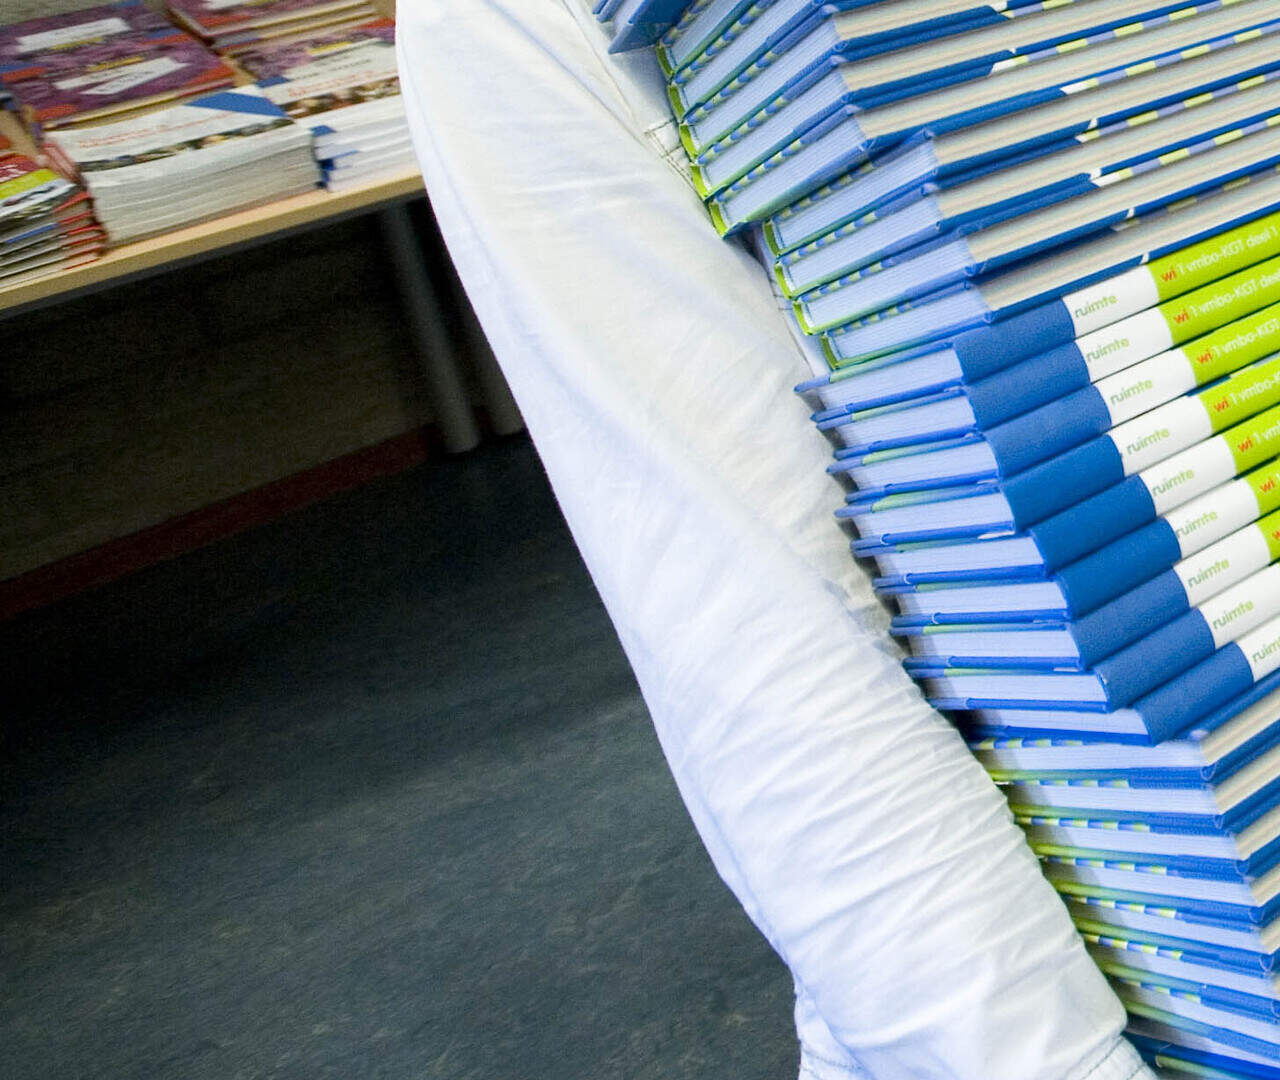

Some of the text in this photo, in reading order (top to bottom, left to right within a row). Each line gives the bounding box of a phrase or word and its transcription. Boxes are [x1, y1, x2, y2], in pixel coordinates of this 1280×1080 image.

[1075, 225, 1280, 319] ruimte wi 1 vmbo-KGT deel 1
[1086, 336, 1130, 363] ruimte
[1174, 308, 1190, 324] wi
[1190, 305, 1198, 318] 1
[1198, 281, 1258, 316] vmbo-KGT
[1110, 378, 1153, 405] ruimte
[1197, 348, 1213, 365] wi
[1213, 345, 1221, 358] 1
[1221, 319, 1280, 356] vmbo-KGT
[1126, 427, 1170, 455] ruimte
[1214, 395, 1230, 412] wi
[1230, 392, 1238, 405] 1
[1151, 468, 1195, 497] ruimte
[1237, 436, 1254, 453] wi
[1253, 431, 1262, 445] 1
[1260, 477, 1276, 494] wi
[1187, 557, 1230, 589] ruimte
[1212, 599, 1254, 630] ruimte
